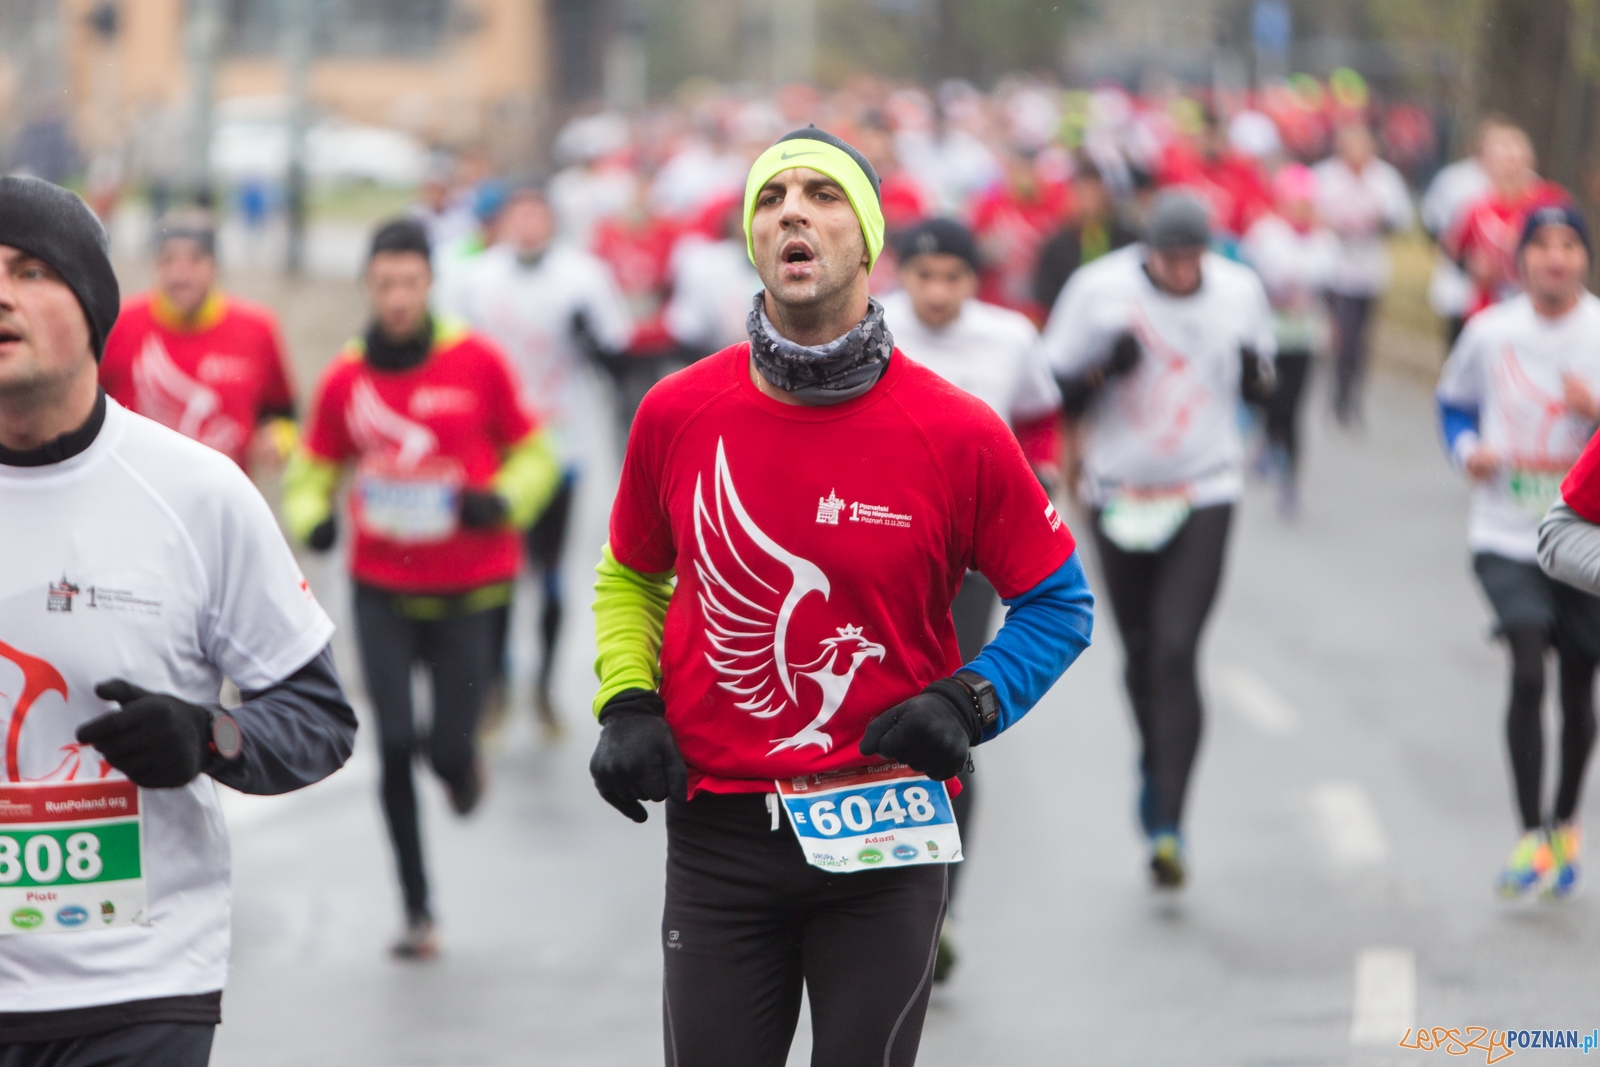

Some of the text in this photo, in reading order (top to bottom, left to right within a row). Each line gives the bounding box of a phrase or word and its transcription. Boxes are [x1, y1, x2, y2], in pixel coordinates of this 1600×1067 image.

[849, 501, 860, 521] 1
[858, 508, 872, 516] Bieg
[859, 503, 889, 512] Poznański
[86, 585, 97, 607] 1
[45, 796, 127, 813] RunPoland.org
[794, 786, 936, 836] E 6048
[864, 835, 895, 844] Adam
[26, 891, 58, 902] Piotr
